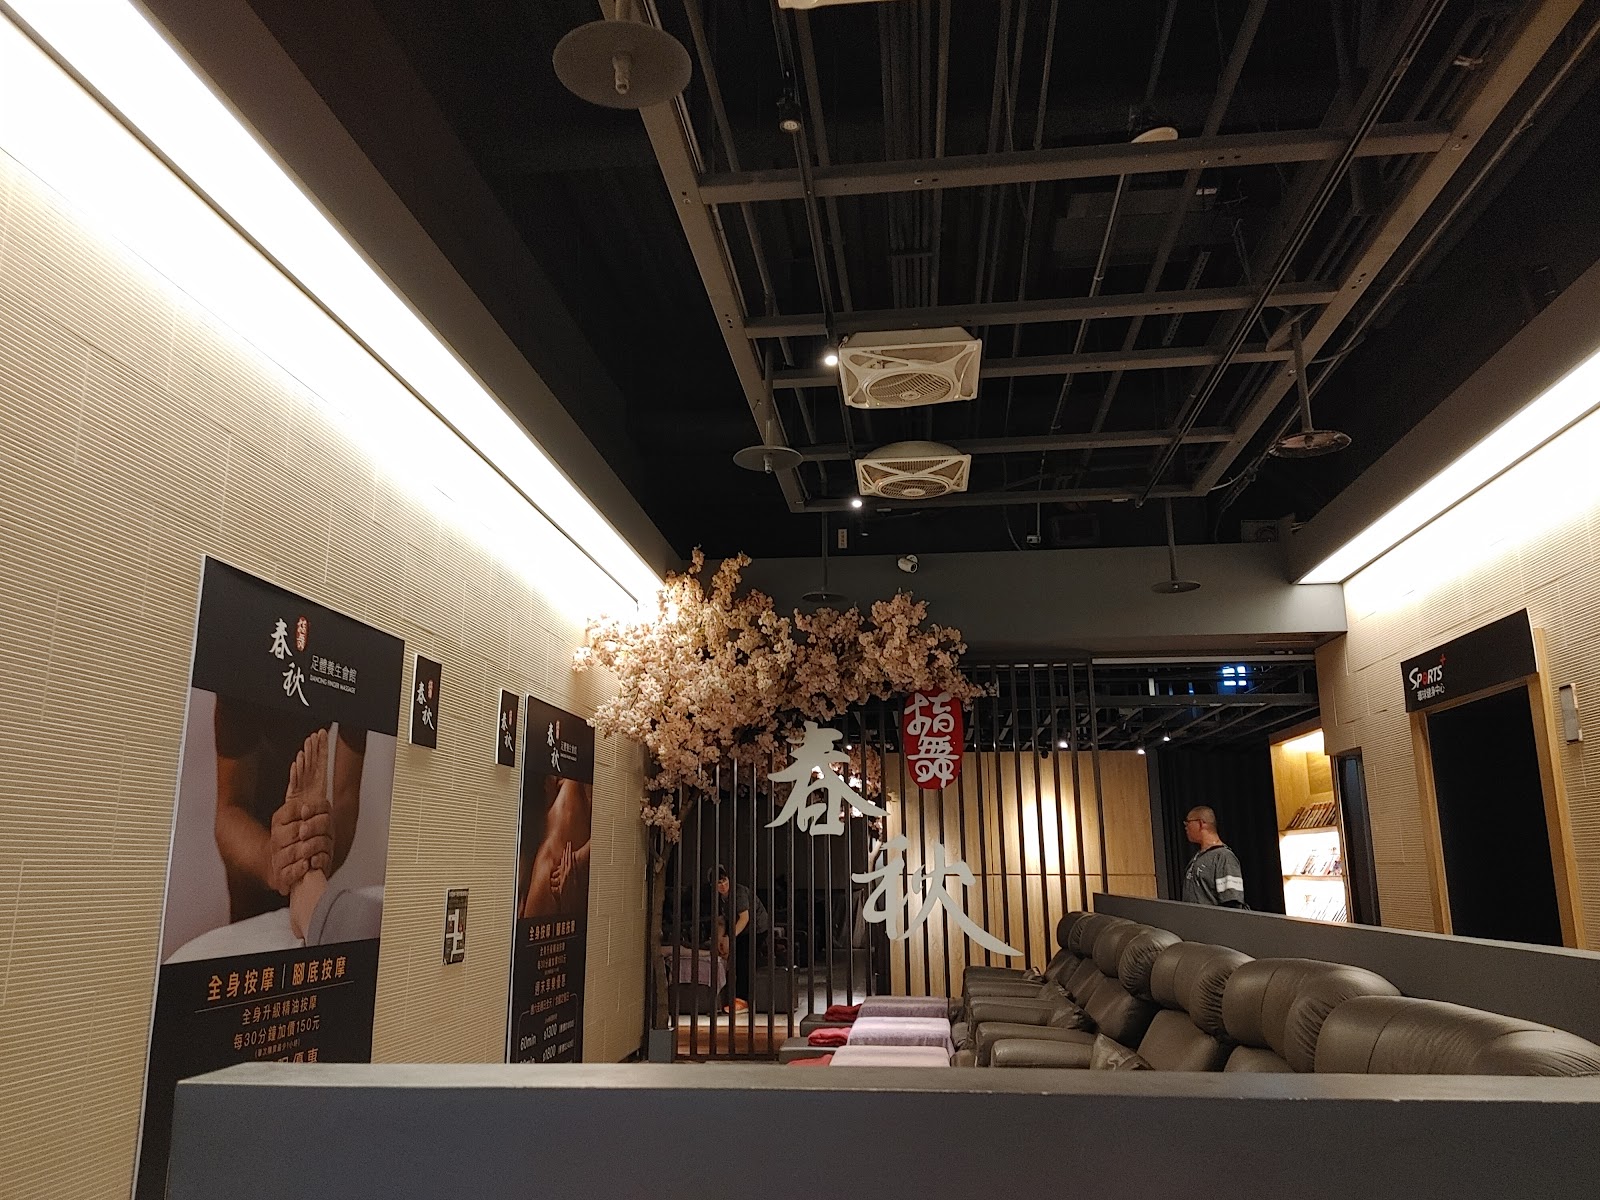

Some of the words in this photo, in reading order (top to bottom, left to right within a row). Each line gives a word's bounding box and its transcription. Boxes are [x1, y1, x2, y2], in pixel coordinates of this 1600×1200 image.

[269, 618, 310, 707] 春秋
[764, 721, 1024, 957] 春秋
[207, 967, 275, 1001] 全身按摩
[292, 956, 347, 986] 腳底按摩
[233, 1014, 320, 1050] 每30分鐘加價150元
[242, 994, 318, 1026] 全身升級精油按摩
